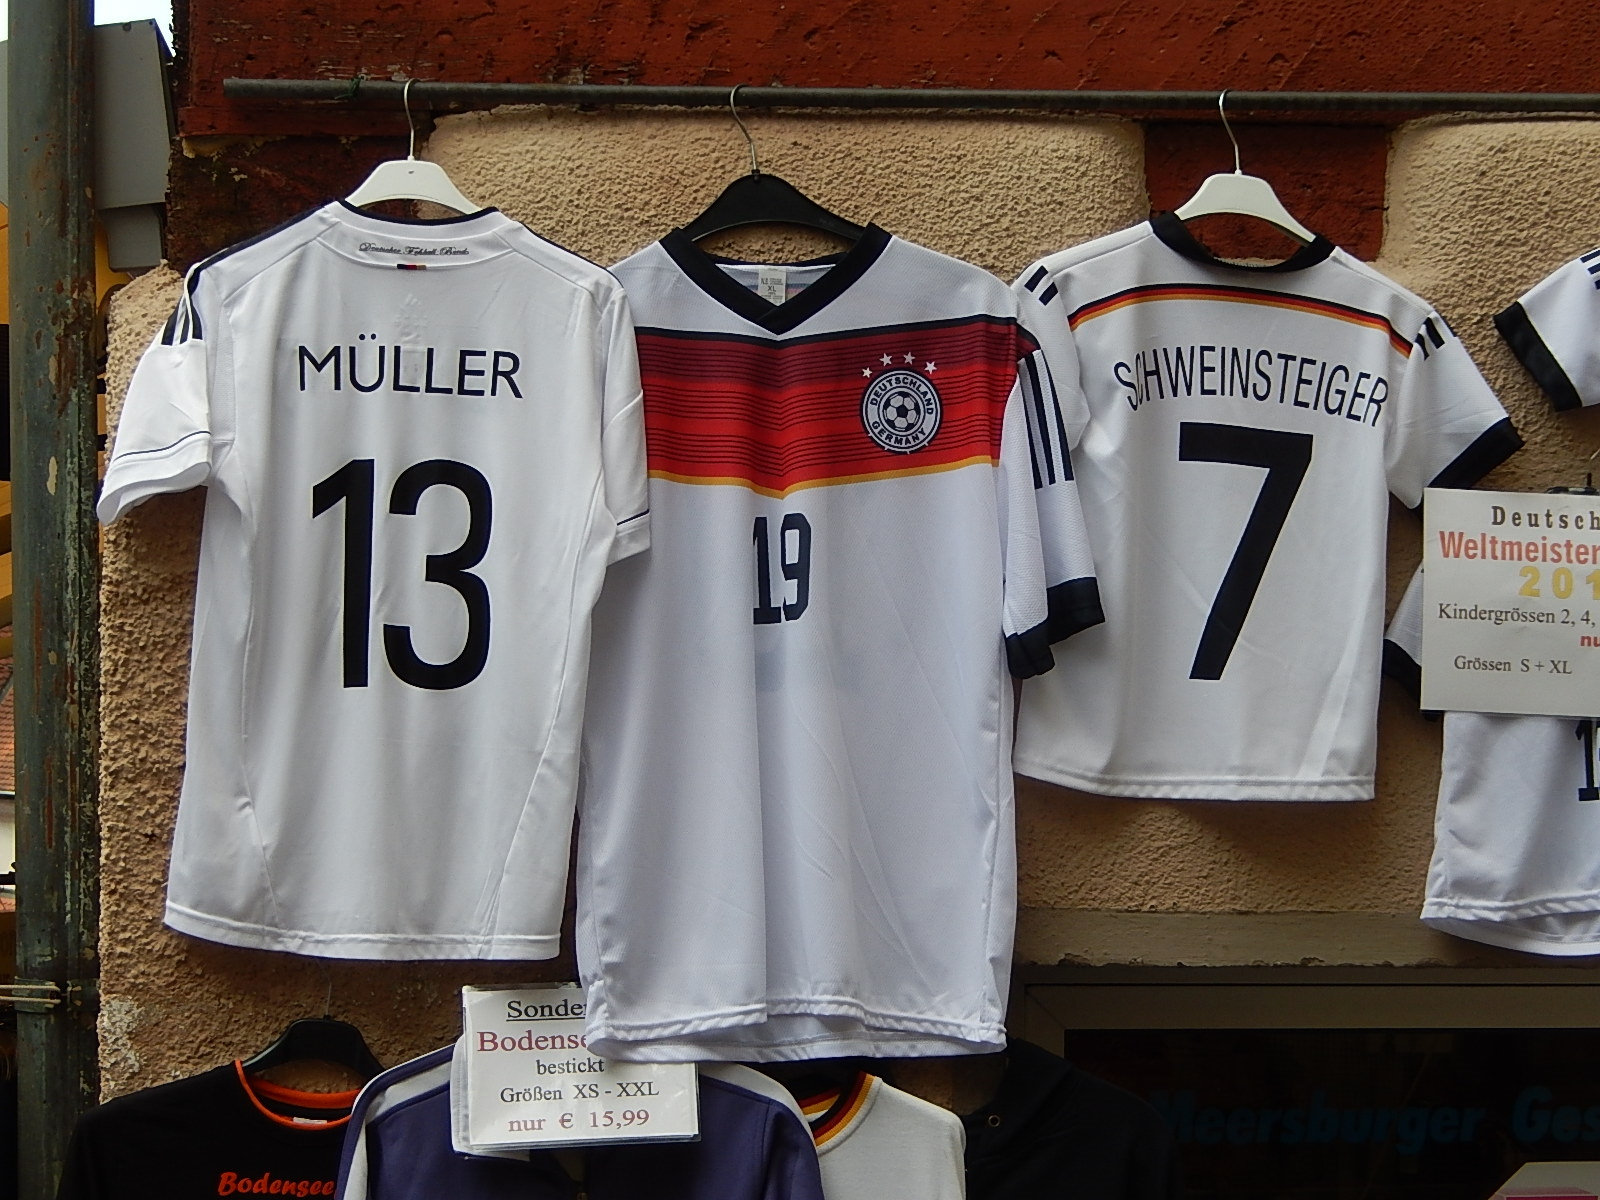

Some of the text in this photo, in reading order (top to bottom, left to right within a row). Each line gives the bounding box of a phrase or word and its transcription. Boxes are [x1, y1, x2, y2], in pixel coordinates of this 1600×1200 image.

[298, 333, 524, 399] MÜLLER
[869, 376, 935, 416] DEUTSCHLAND
[1113, 345, 1389, 427] SCHWEINSTEIGER
[871, 420, 927, 446] GERMANY
[1491, 505, 1600, 531] Deutsch
[1178, 421, 1314, 681] 7
[1439, 530, 1600, 565] Weltmeister
[312, 458, 493, 691] 13
[753, 512, 812, 625] 19
[1518, 565, 1600, 601] 201
[1438, 602, 1597, 628] Kindergrössen 2, 4,
[1454, 655, 1512, 673] Grössen
[1520, 658, 1530, 673] S
[1549, 659, 1573, 675] XL
[1575, 717, 1600, 802] 1
[506, 998, 586, 1020] Sonde
[536, 1056, 605, 1076] bestickt
[500, 1085, 563, 1104] Größen
[573, 1083, 600, 1099] XS
[616, 1081, 660, 1098] XXL
[508, 1109, 650, 1133] nur € 15,99
[1150, 1089, 1486, 1155] Meersburger
[218, 1171, 335, 1198] Bodensee
